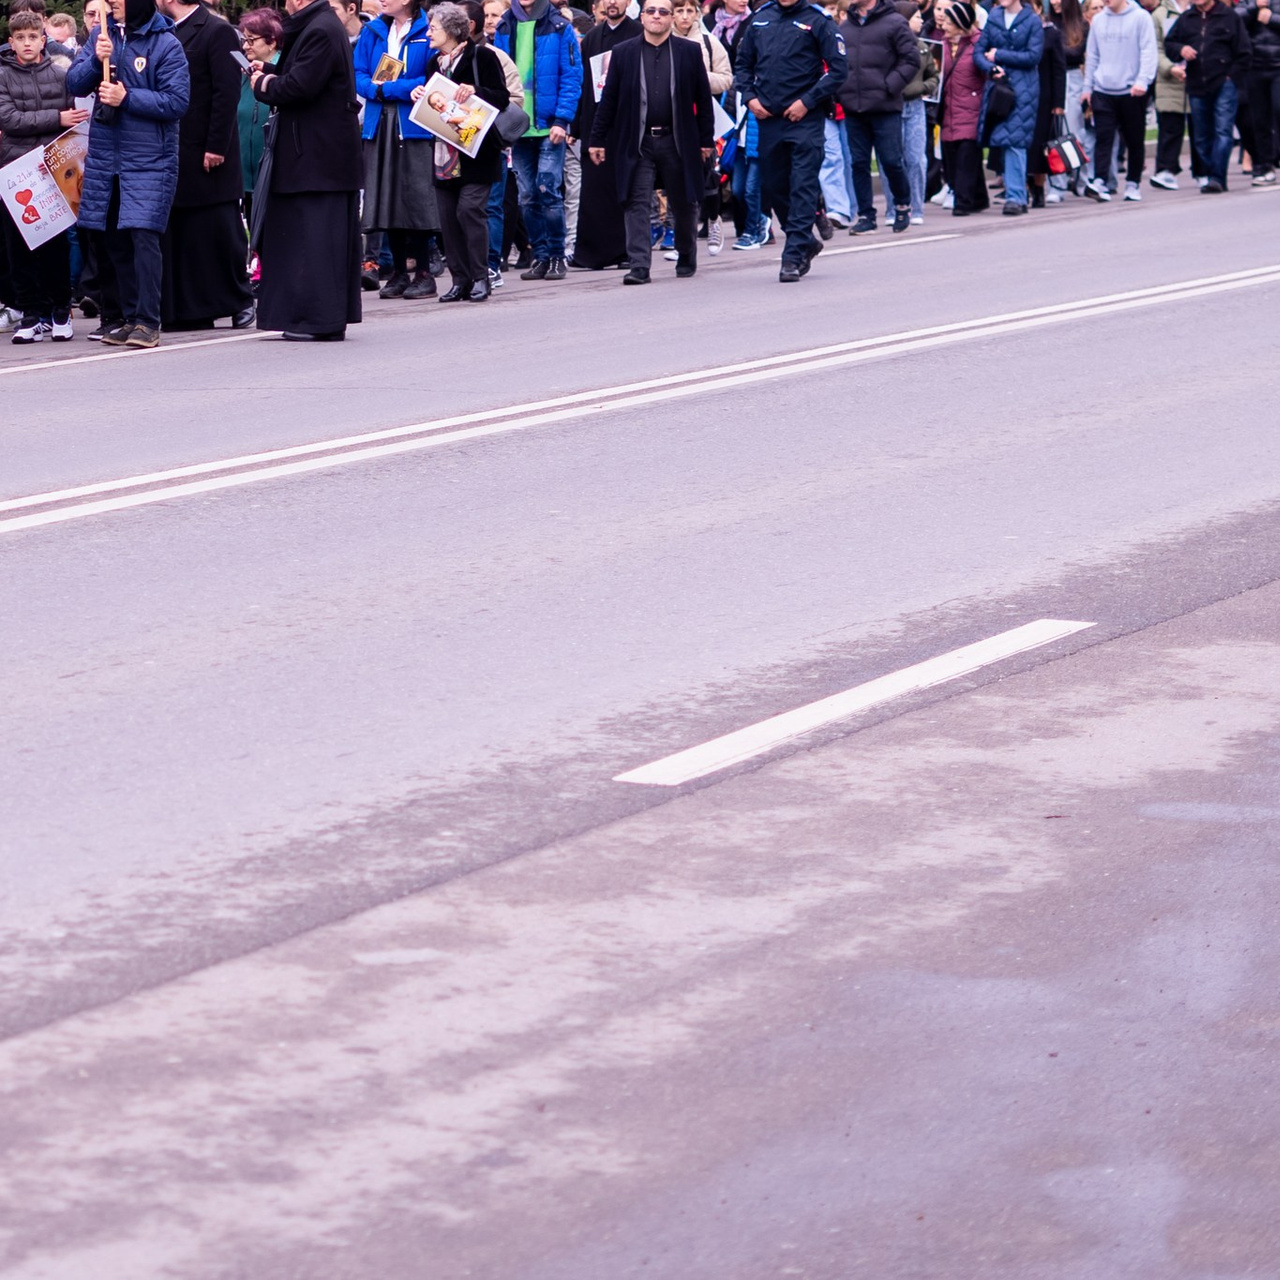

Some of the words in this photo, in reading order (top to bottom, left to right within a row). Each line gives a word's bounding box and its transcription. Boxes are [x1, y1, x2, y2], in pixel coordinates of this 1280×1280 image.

[44, 144, 61, 160] Sunt
[47, 156, 58, 166] un
[51, 163, 61, 172] nu
[7, 180, 17, 190] La
[18, 172, 27, 184] 21
[35, 221, 49, 232] deja
[49, 206, 68, 222] BATE
